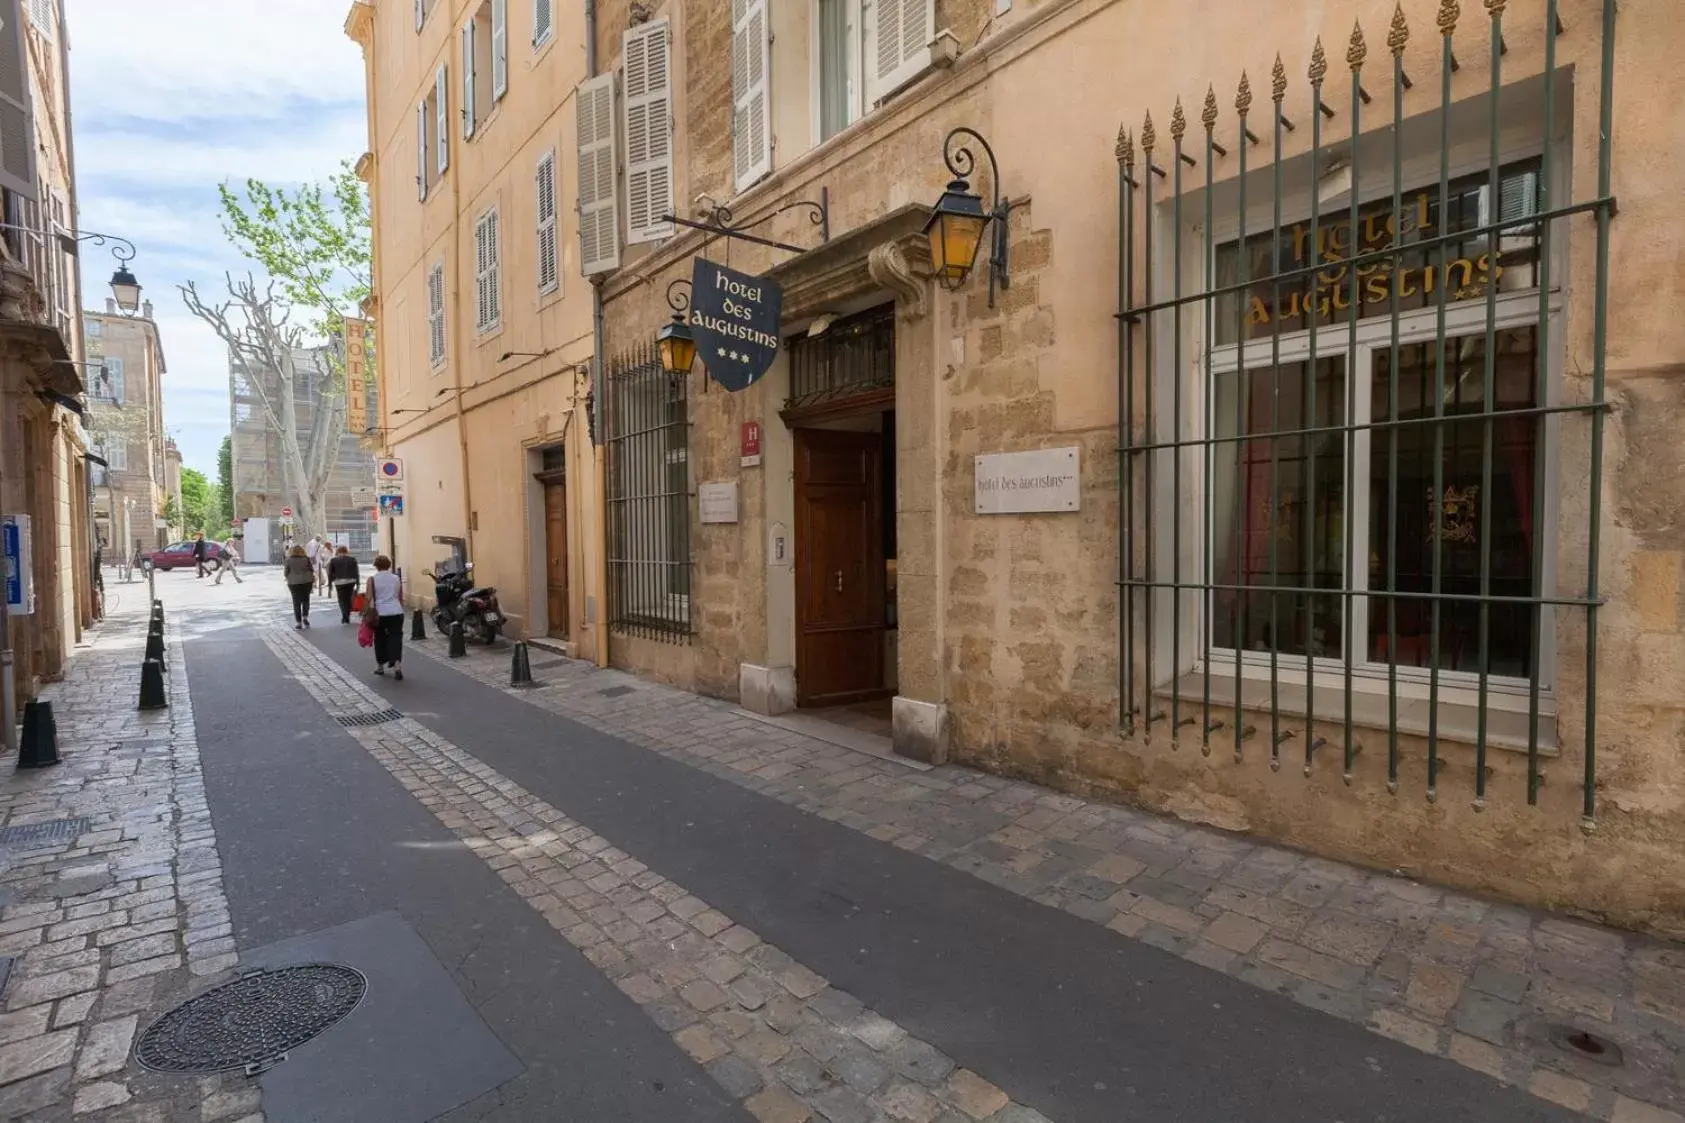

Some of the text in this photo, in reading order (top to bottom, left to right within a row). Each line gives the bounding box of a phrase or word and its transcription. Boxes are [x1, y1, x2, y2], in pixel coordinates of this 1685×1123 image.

[715, 270, 762, 303] hotel
[723, 298, 752, 320] des
[349, 323, 365, 411] HOTEL
[748, 427, 758, 441] H
